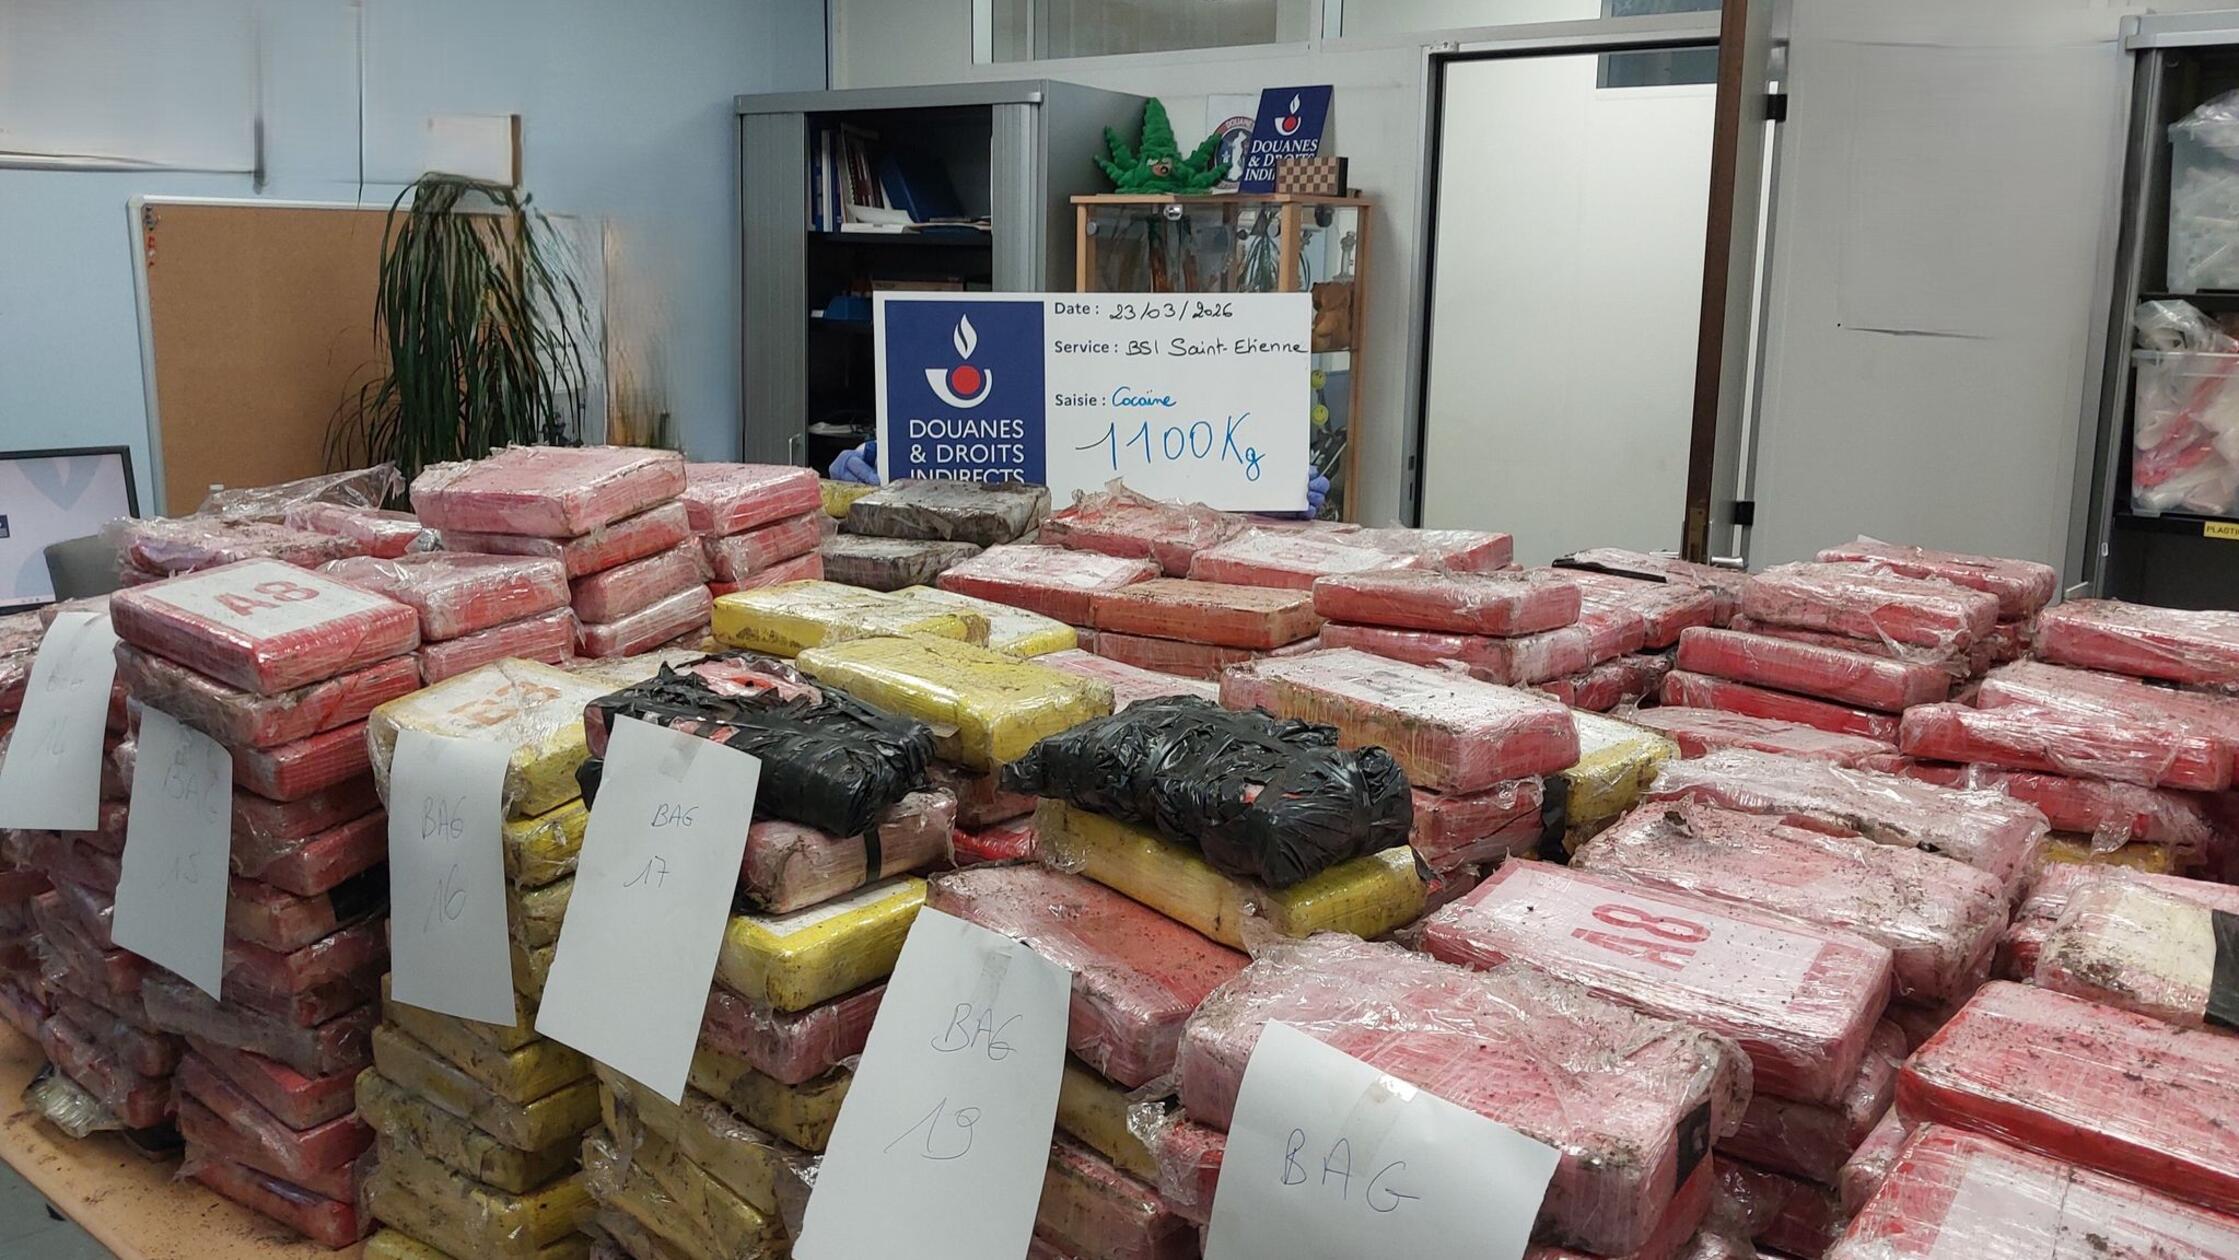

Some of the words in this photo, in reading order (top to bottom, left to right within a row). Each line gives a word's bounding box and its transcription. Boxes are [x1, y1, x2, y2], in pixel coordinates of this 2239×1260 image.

[1251, 139, 1318, 153] DOUANES
[1248, 155, 1261, 167] &
[1243, 168, 1275, 181] INDI
[1054, 302, 1090, 315] Date
[1109, 300, 1233, 321] 23/03/2026
[1054, 340, 1110, 354] Service
[1126, 340, 1159, 356] BSI
[1055, 393, 1098, 407] Saisie
[909, 419, 1025, 439] DOUANES
[909, 444, 927, 463] &
[936, 444, 1025, 463] DROITS
[2206, 525, 2239, 535] PLASTI
[651, 803, 699, 827] BAG
[623, 855, 671, 888] 17
[931, 1003, 1024, 1061] BAG
[1281, 1128, 1420, 1212] BAG
